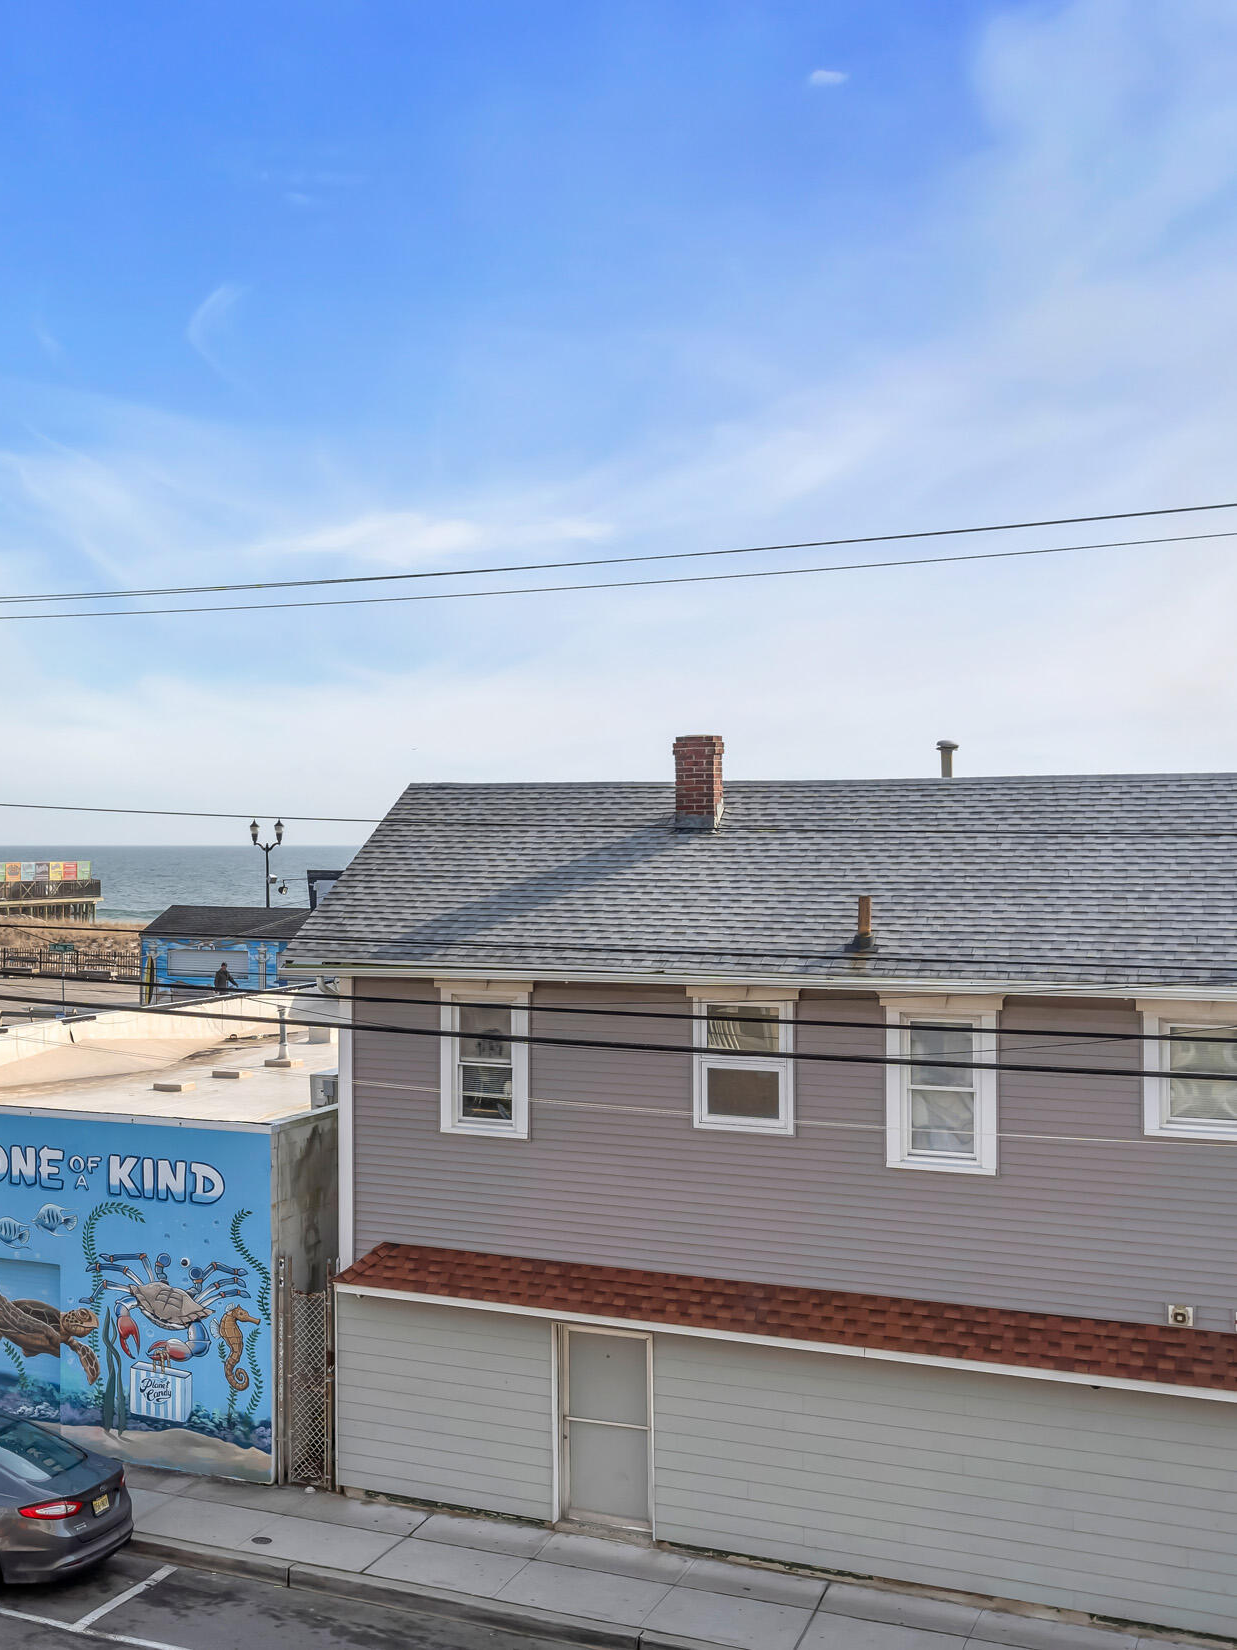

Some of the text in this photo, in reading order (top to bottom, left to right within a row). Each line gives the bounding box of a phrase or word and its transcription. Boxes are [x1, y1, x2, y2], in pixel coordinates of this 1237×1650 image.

[69, 1155, 102, 1174] OF
[74, 1174, 89, 1190] A
[108, 1154, 225, 1204] KIND
[140, 1378, 170, 1393] Planet
[146, 1389, 171, 1402] Candy
